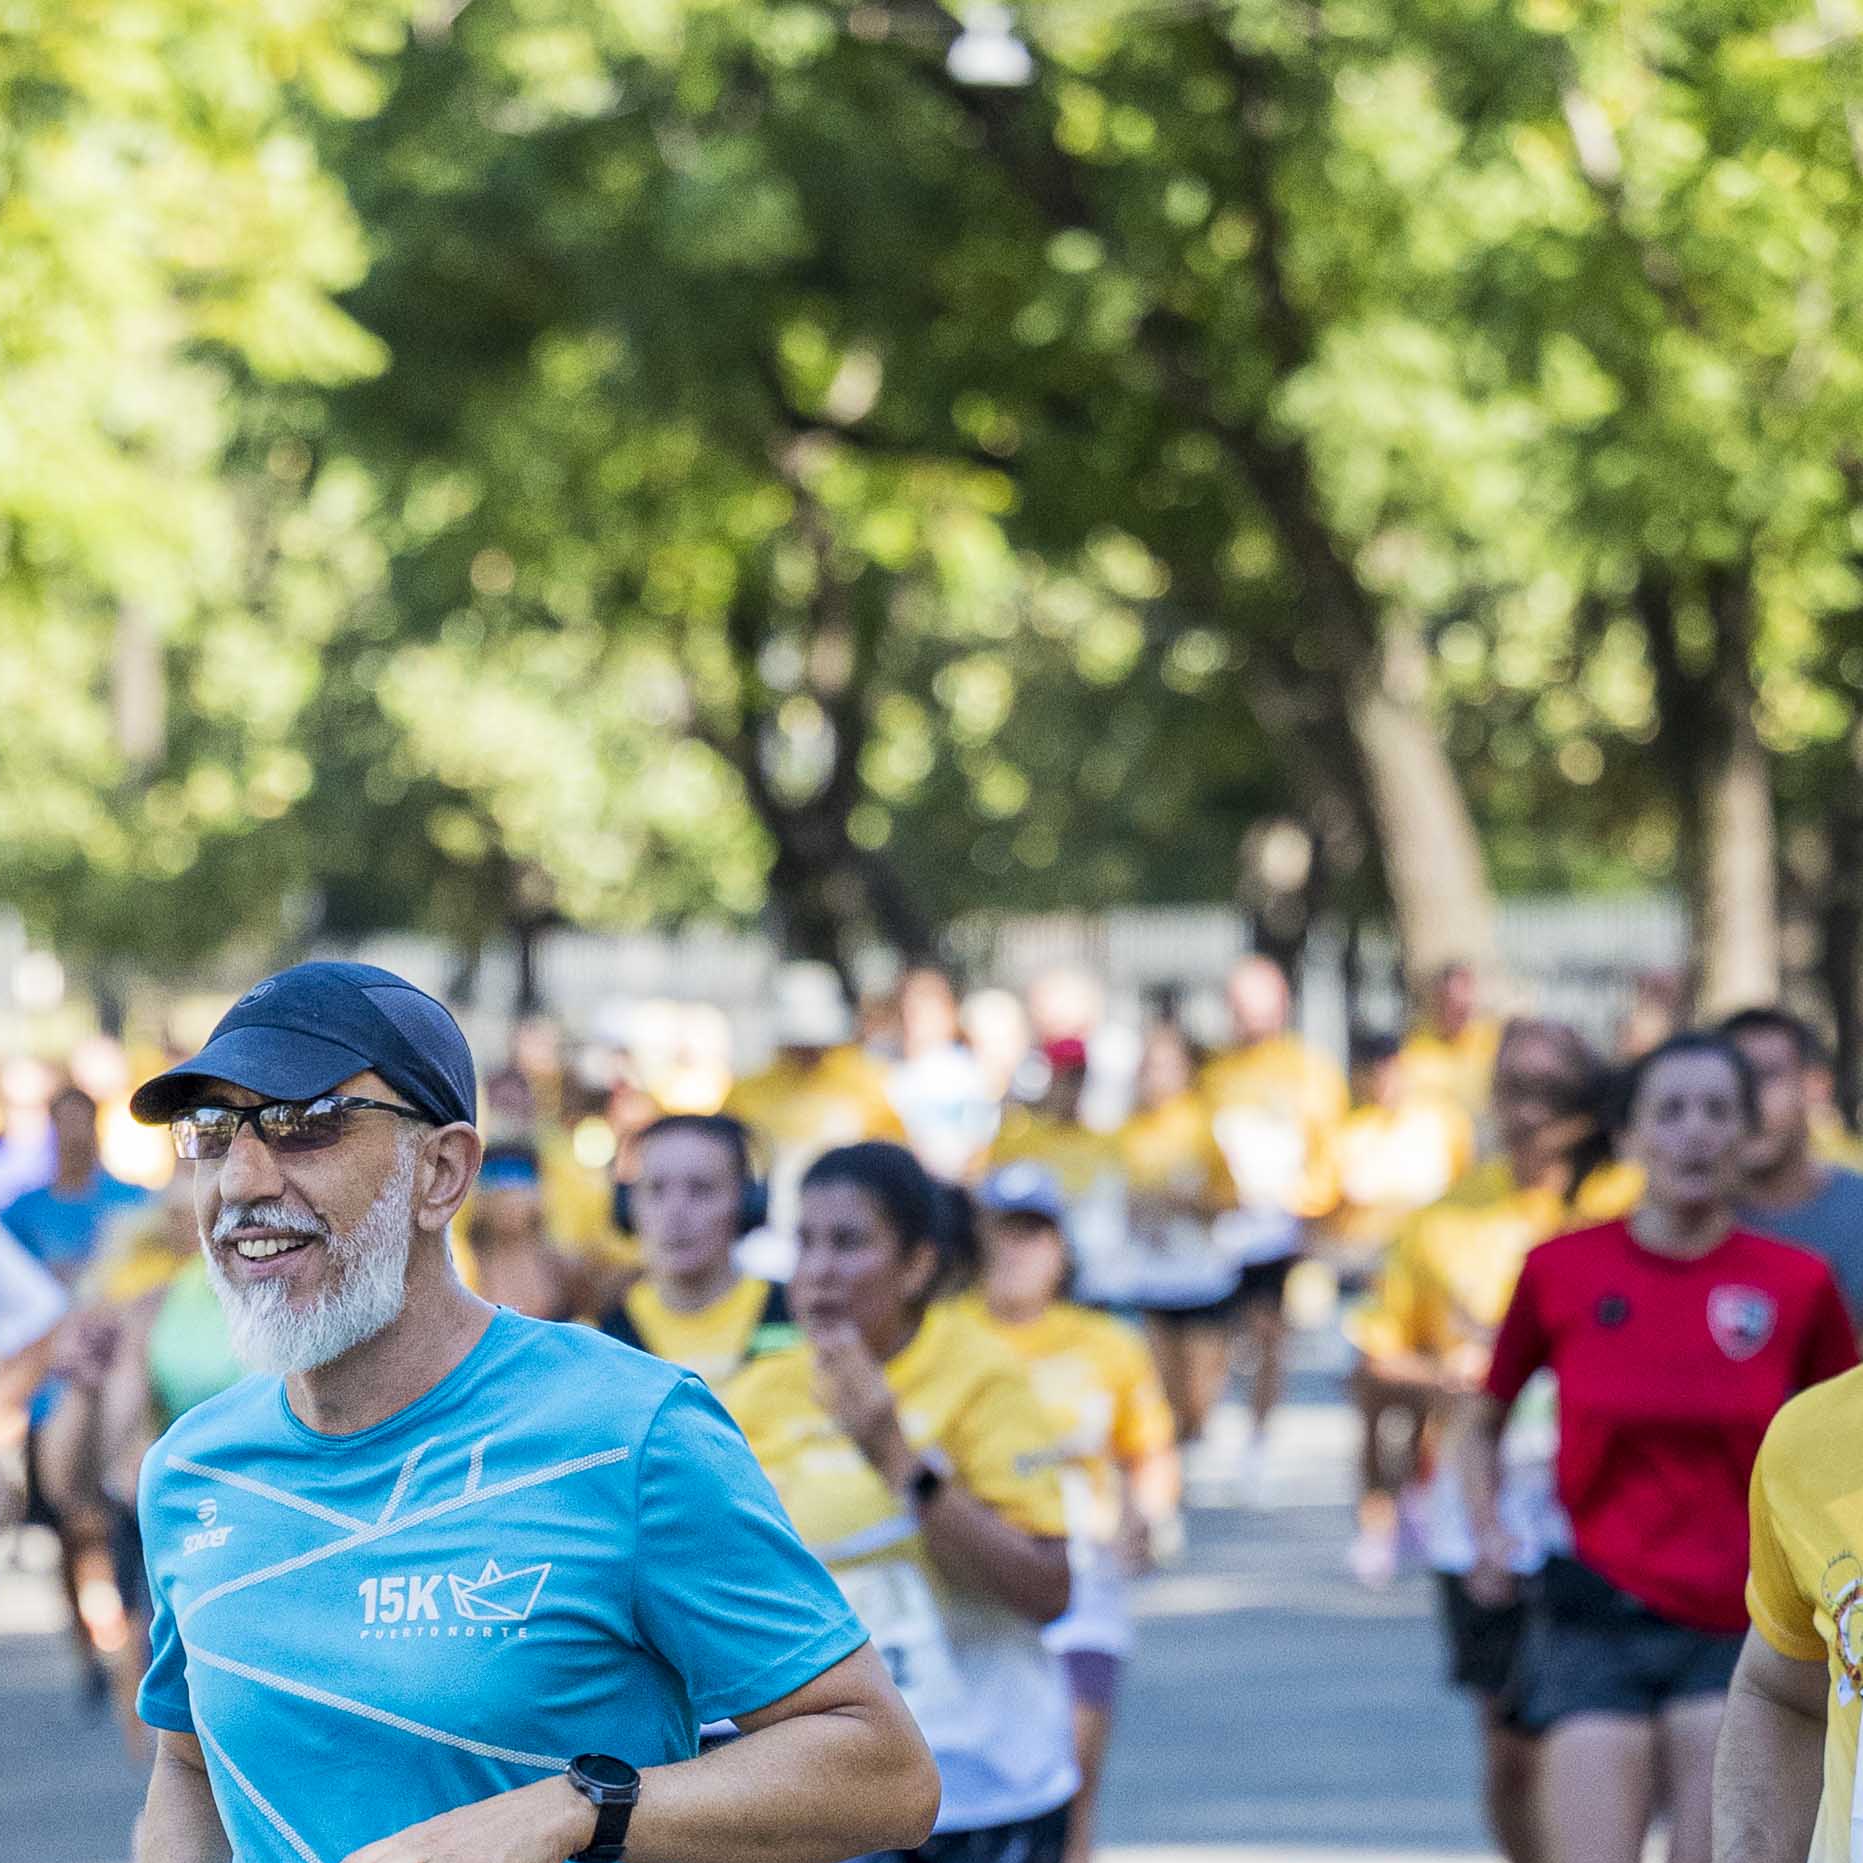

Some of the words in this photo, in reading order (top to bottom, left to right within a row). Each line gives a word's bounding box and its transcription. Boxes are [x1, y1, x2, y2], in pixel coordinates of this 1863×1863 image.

[358, 1574, 444, 1624] 15K
[359, 1627, 438, 1639] PUERTO
[448, 1626, 528, 1638] NORTE
